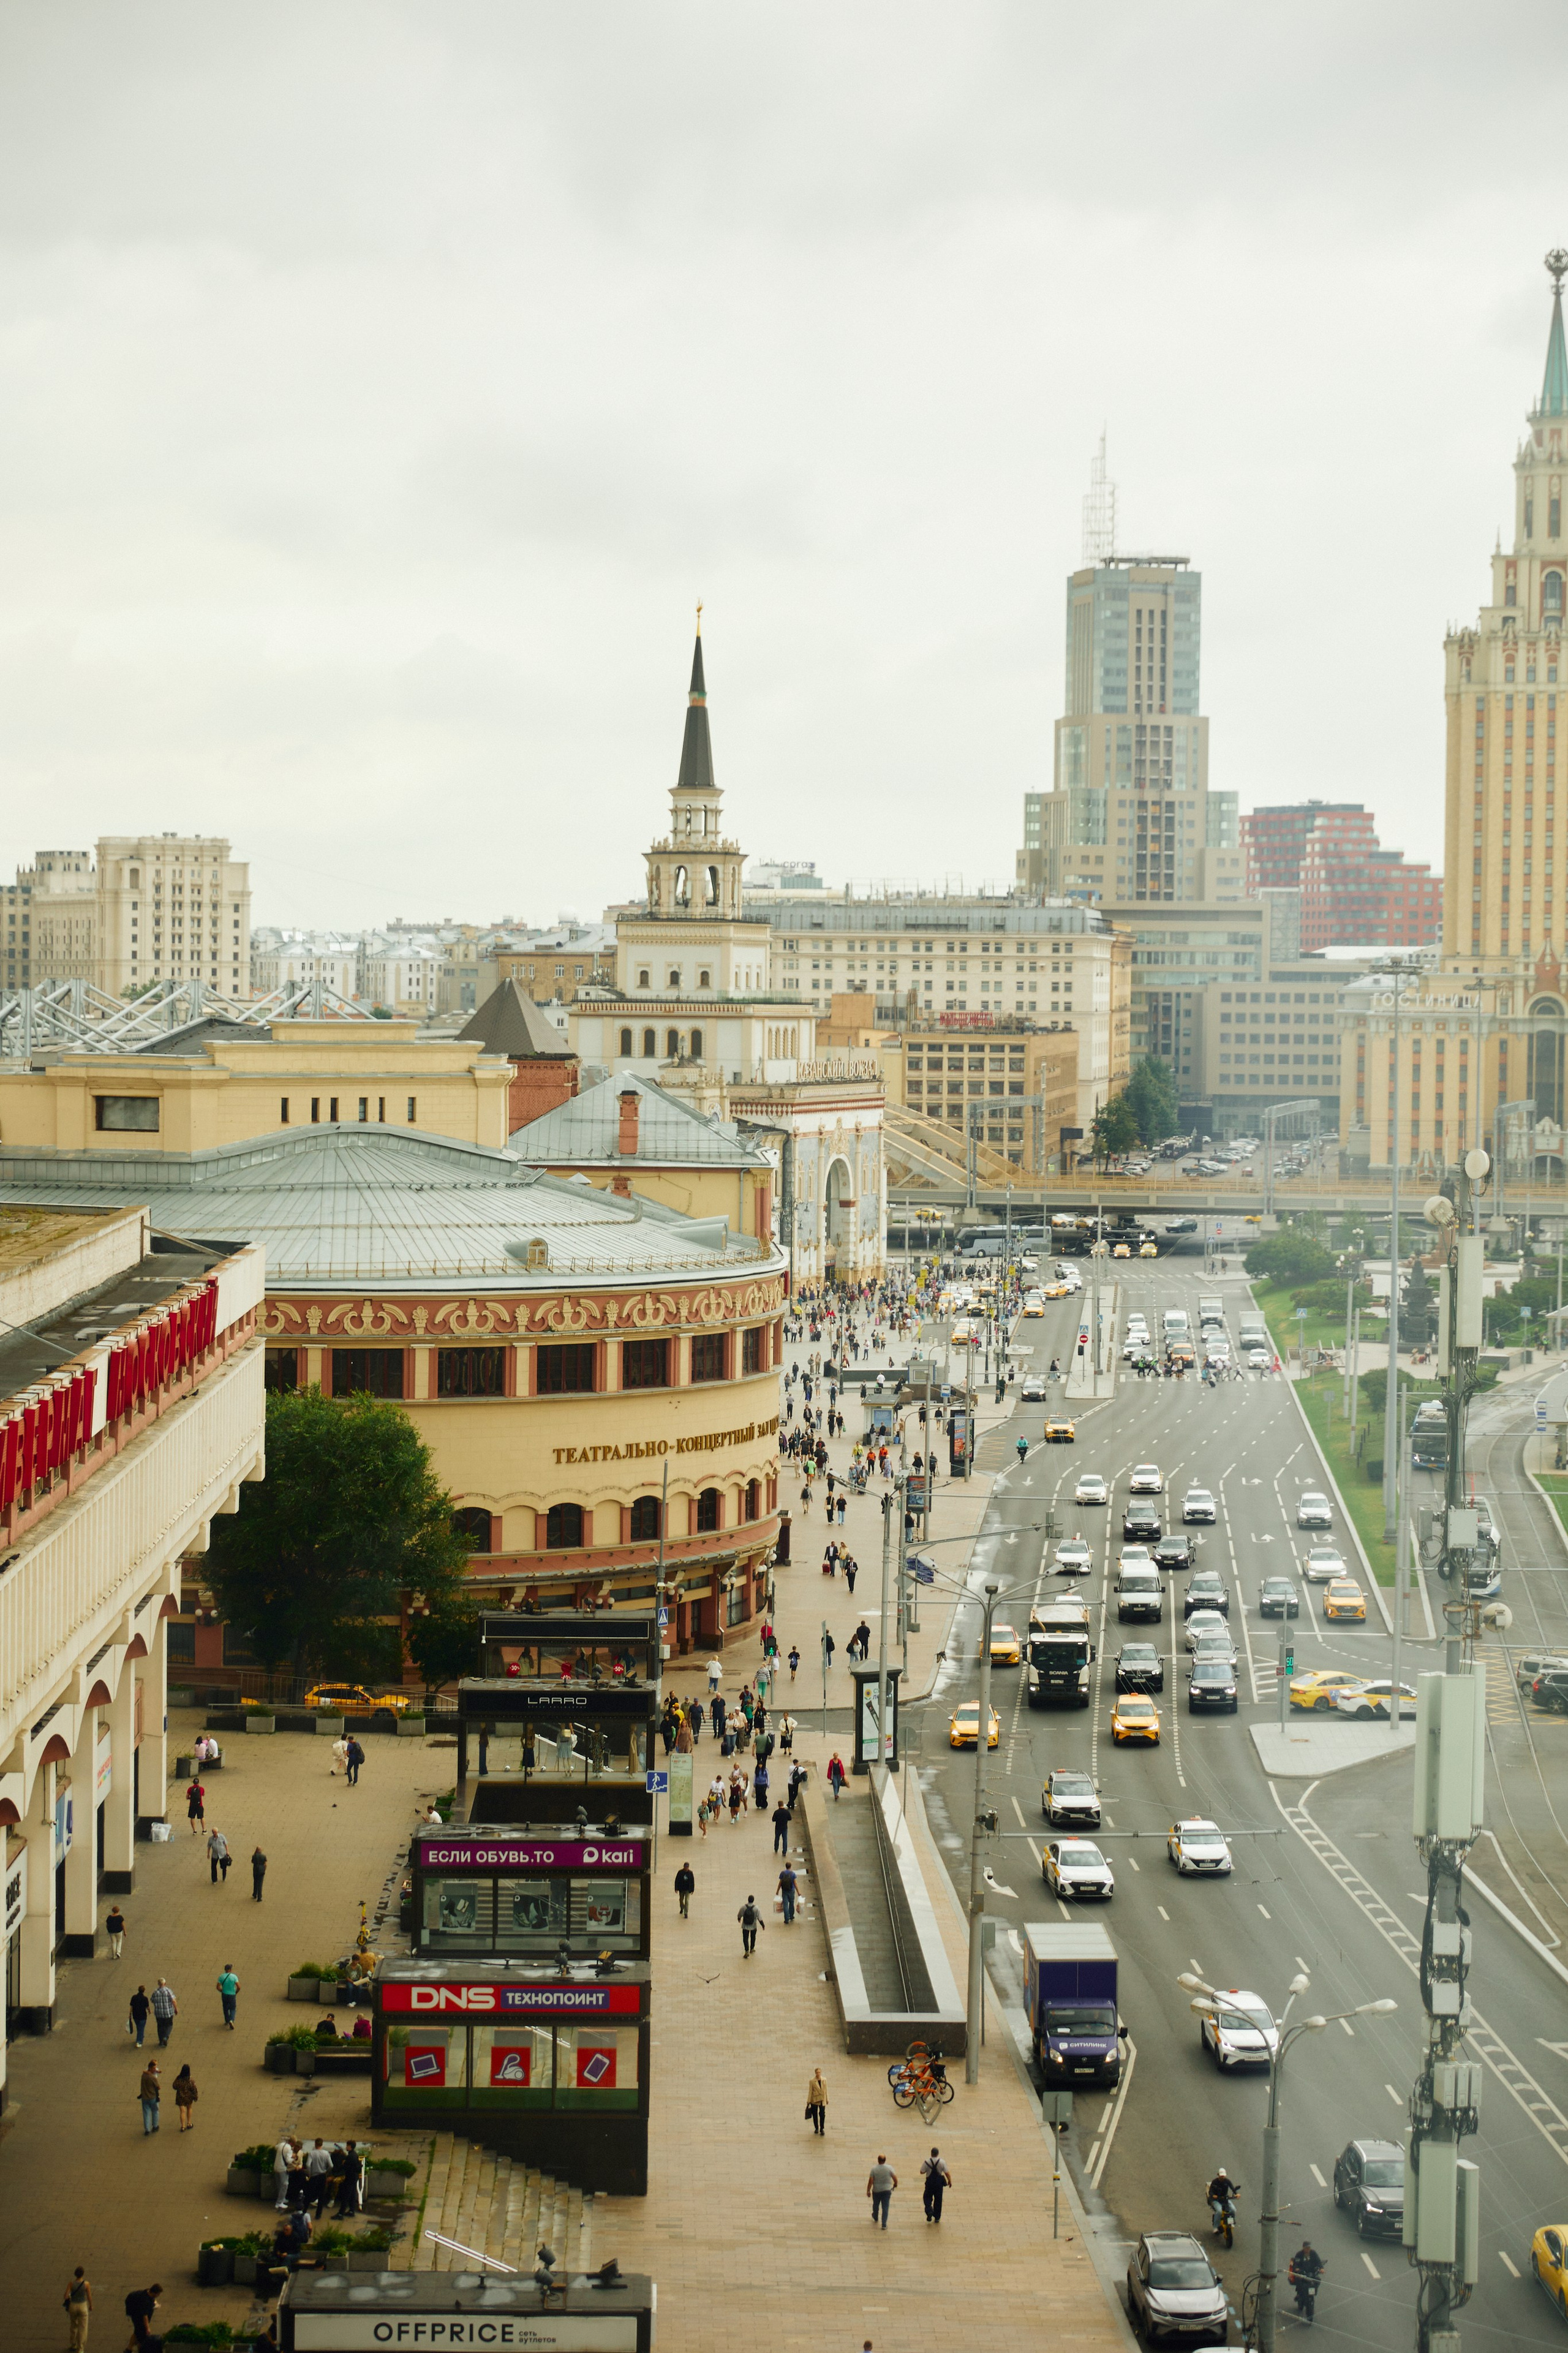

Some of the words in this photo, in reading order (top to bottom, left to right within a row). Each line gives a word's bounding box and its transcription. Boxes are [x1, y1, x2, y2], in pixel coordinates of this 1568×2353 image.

[797, 1058, 844, 1079] КАЗАНСКИЙ
[849, 1059, 877, 1076] ВОКЗАЛ
[1286, 1657, 1294, 1666] 50
[429, 1851, 471, 1862] ЕСЛИ
[602, 1849, 633, 1863] kari
[411, 1987, 496, 2009] DNS
[506, 1993, 605, 2005] ТЕХНОПОИНТ
[374, 2322, 514, 2343] OFFPRICE
